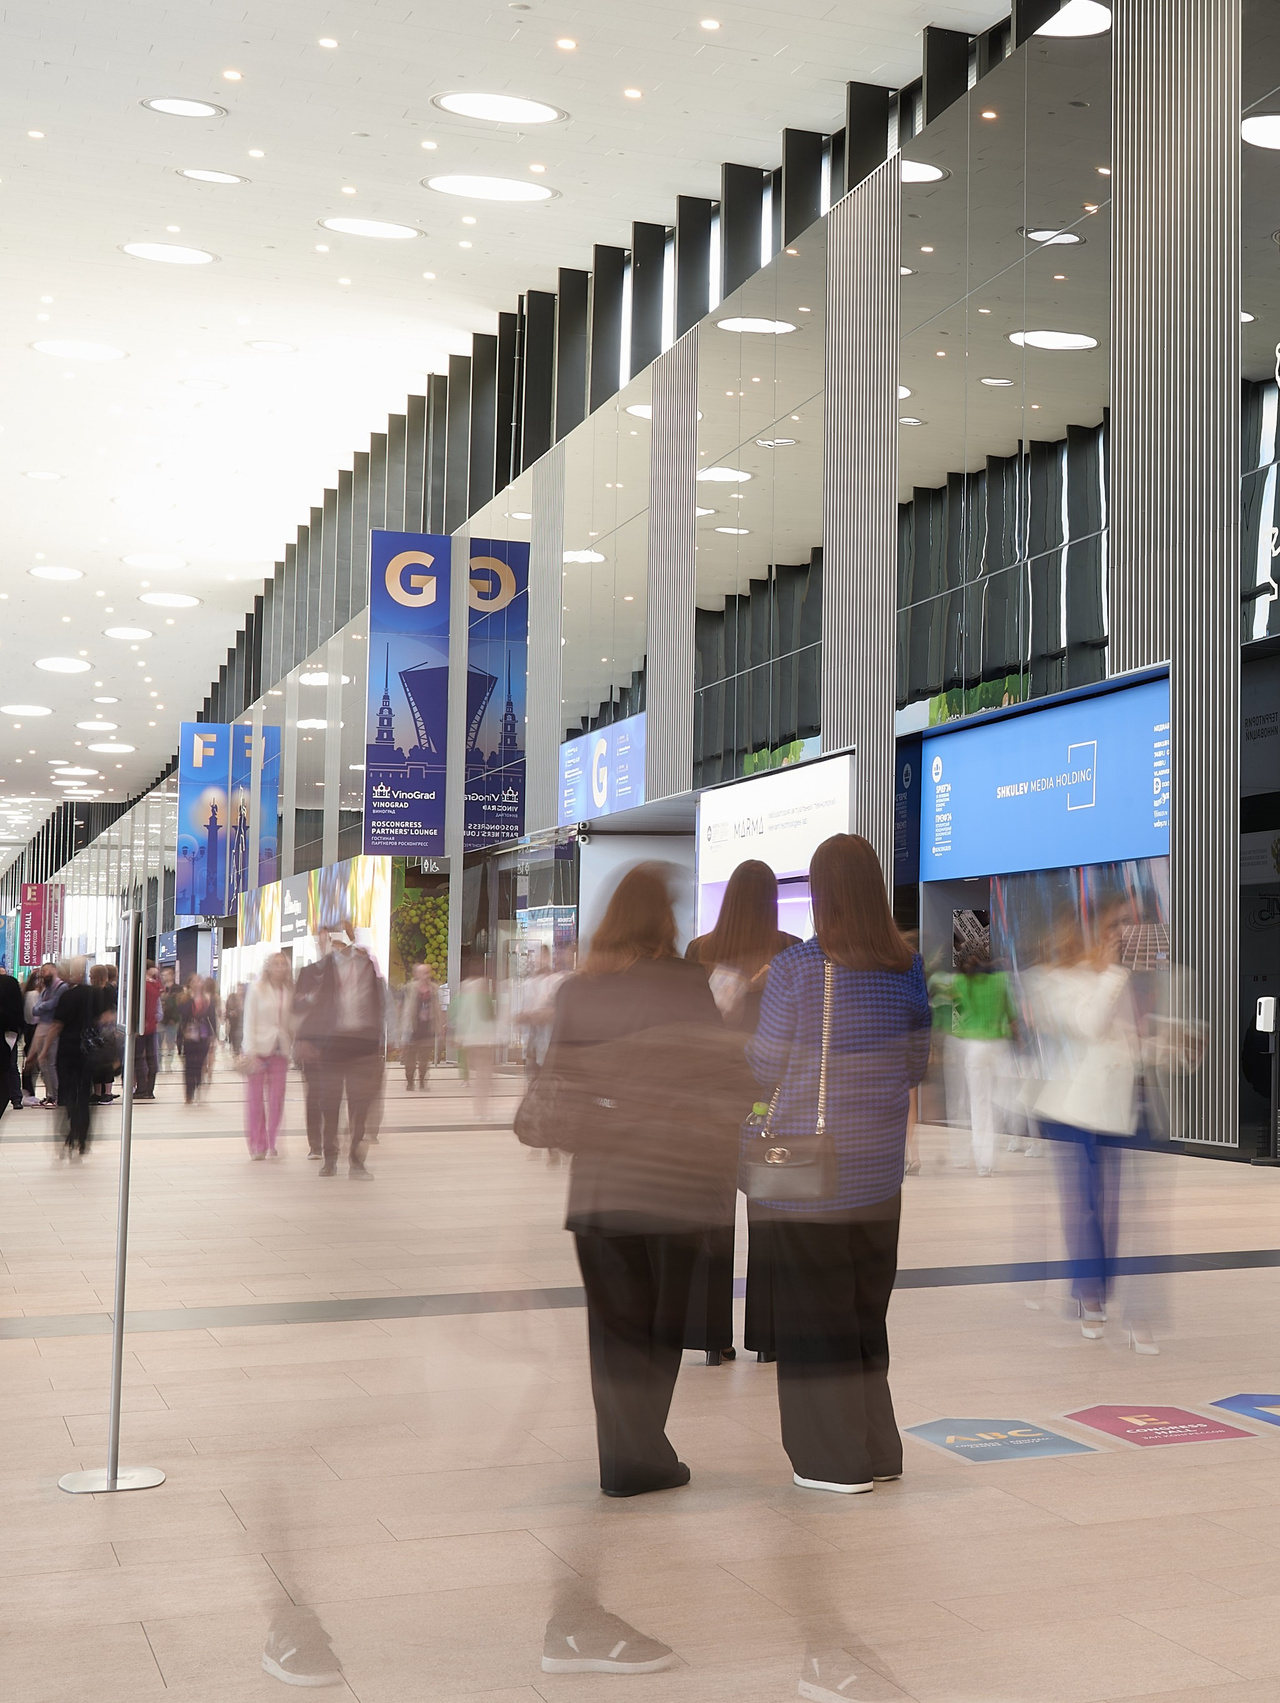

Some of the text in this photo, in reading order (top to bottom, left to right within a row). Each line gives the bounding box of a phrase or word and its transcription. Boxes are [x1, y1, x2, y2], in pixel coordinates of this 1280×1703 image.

[385, 550, 437, 608] G
[193, 733, 217, 768] F
[592, 738, 608, 808] G
[997, 768, 1092, 800] SHKULEV MEDIA HOLDING
[391, 790, 436, 800] VinoGrad
[372, 801, 409, 809] VINOGRAD
[371, 821, 422, 829] ROSCONGRESS
[27, 885, 37, 901] E
[24, 912, 32, 928] HALL
[23, 930, 32, 964] CONGRESS
[1117, 1414, 1171, 1427] E
[1126, 1423, 1208, 1434] CONGRESS
[946, 1429, 1044, 1444] ABC
